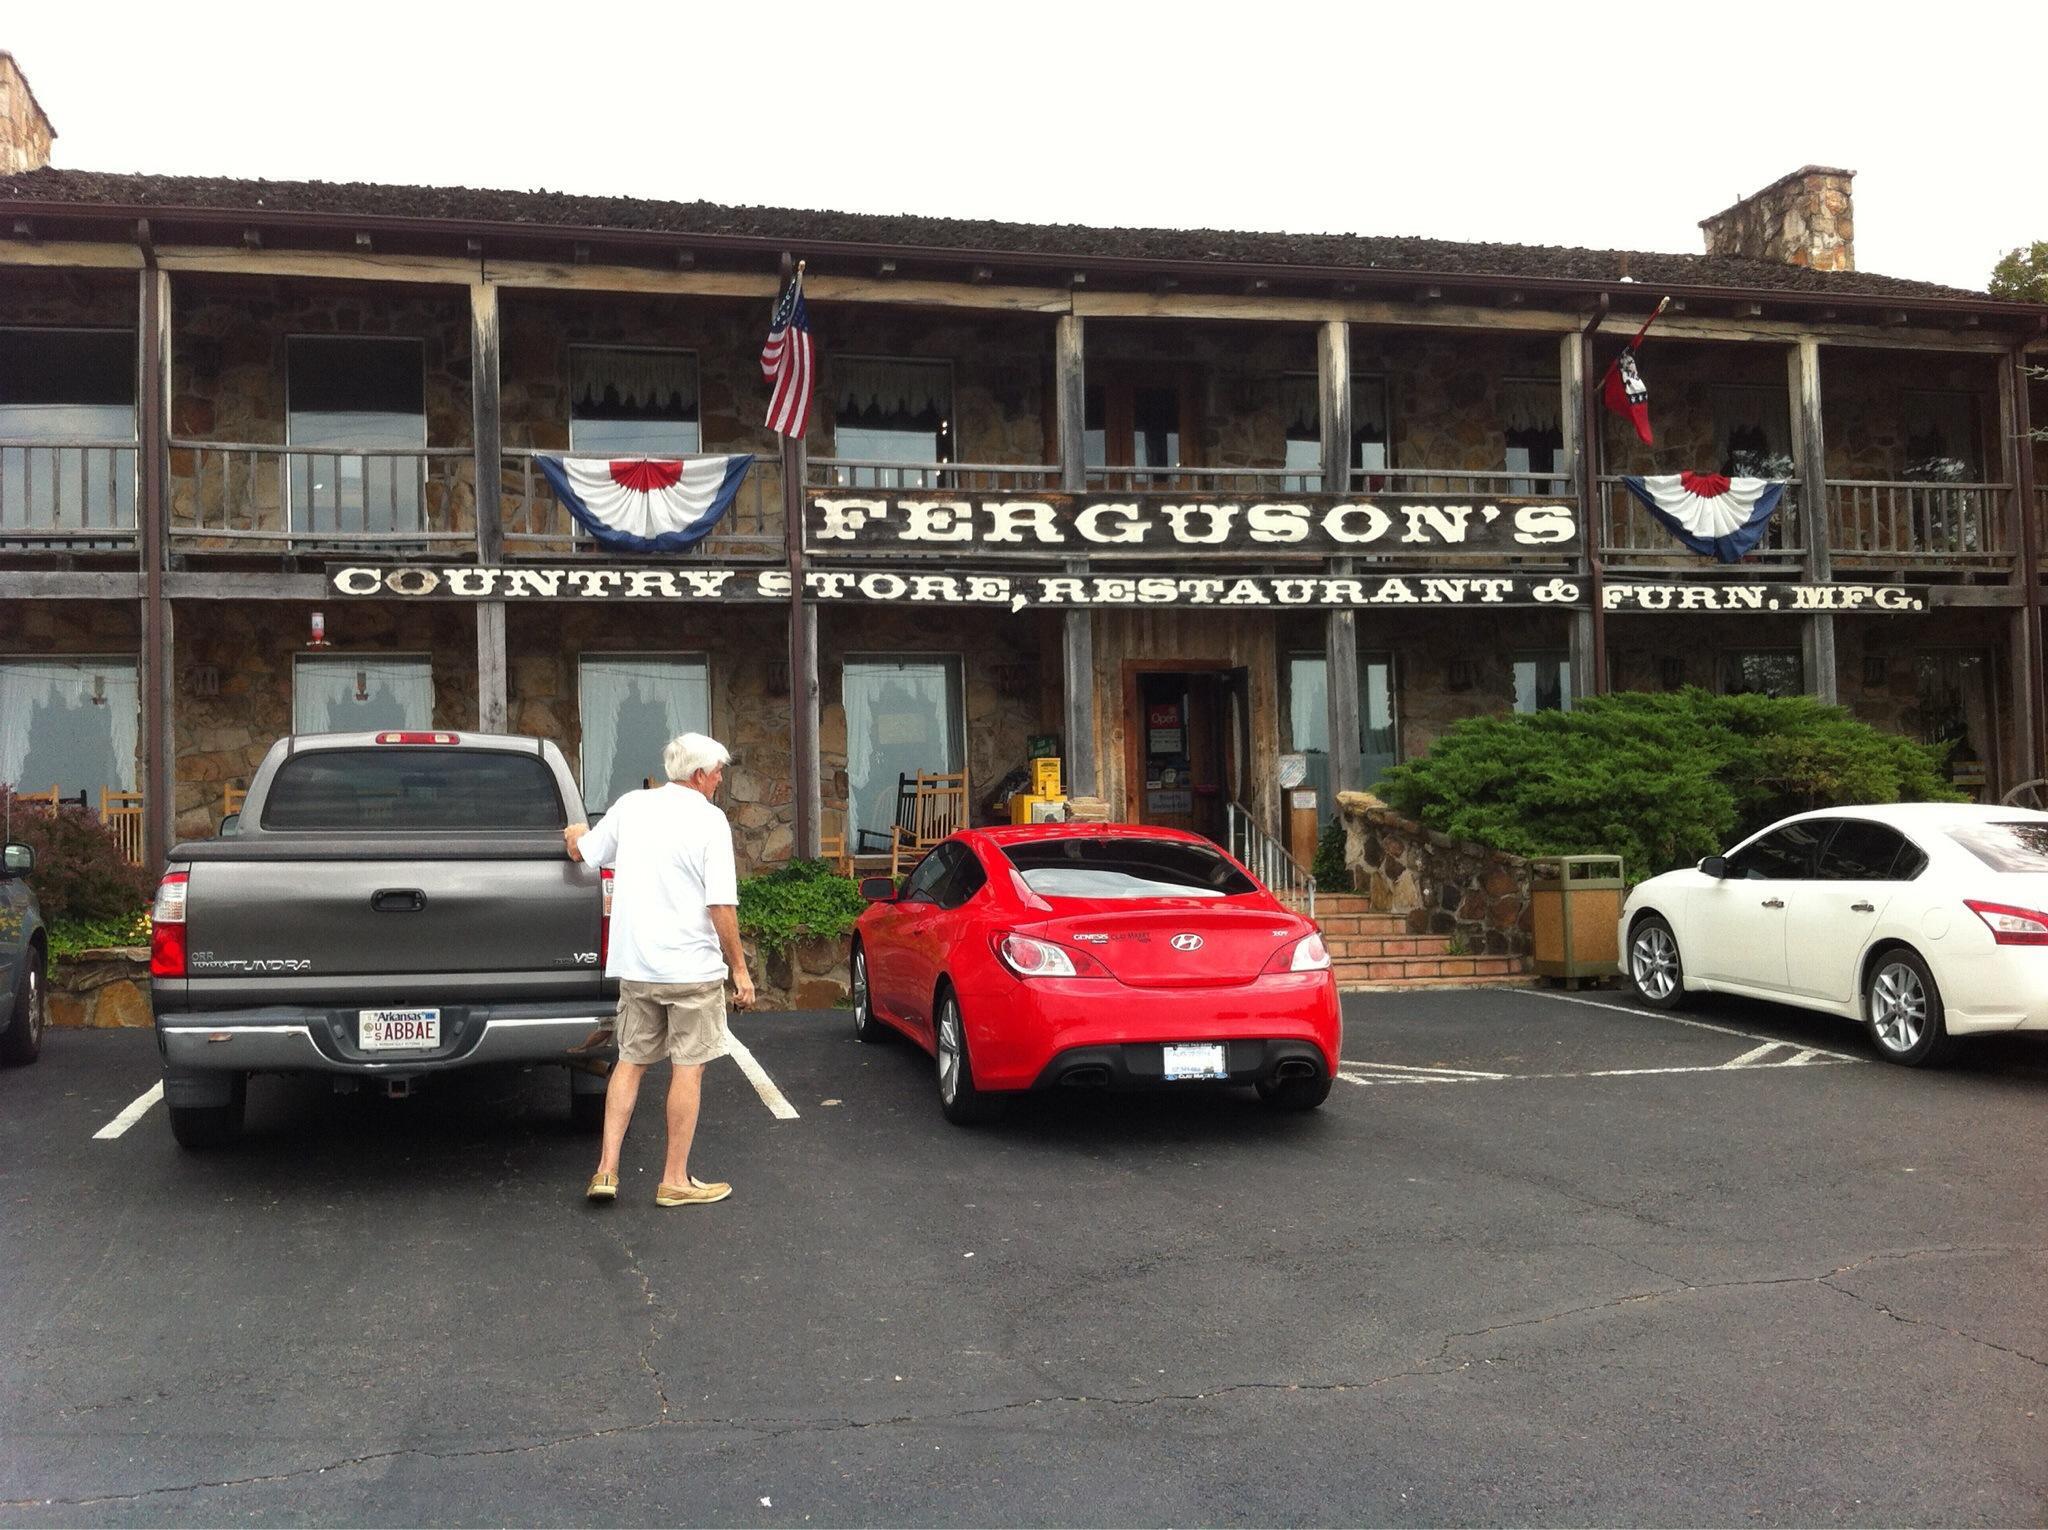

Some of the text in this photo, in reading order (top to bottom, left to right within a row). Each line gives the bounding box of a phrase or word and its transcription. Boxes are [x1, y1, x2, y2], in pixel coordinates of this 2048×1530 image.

[814, 499, 1577, 544] FERGUSON'S
[334, 567, 735, 597] COUNTRY
[1038, 577, 1514, 605] RESTAURANT
[1532, 578, 1580, 603] &
[1602, 585, 1779, 611] FURN.
[1792, 587, 1924, 611] MFG.
[1151, 712, 1177, 724] Open
[573, 952, 598, 964] V8
[229, 959, 311, 971] TUNDRA
[378, 1012, 421, 1022] Arkansas
[384, 1021, 436, 1040] ABBAE
